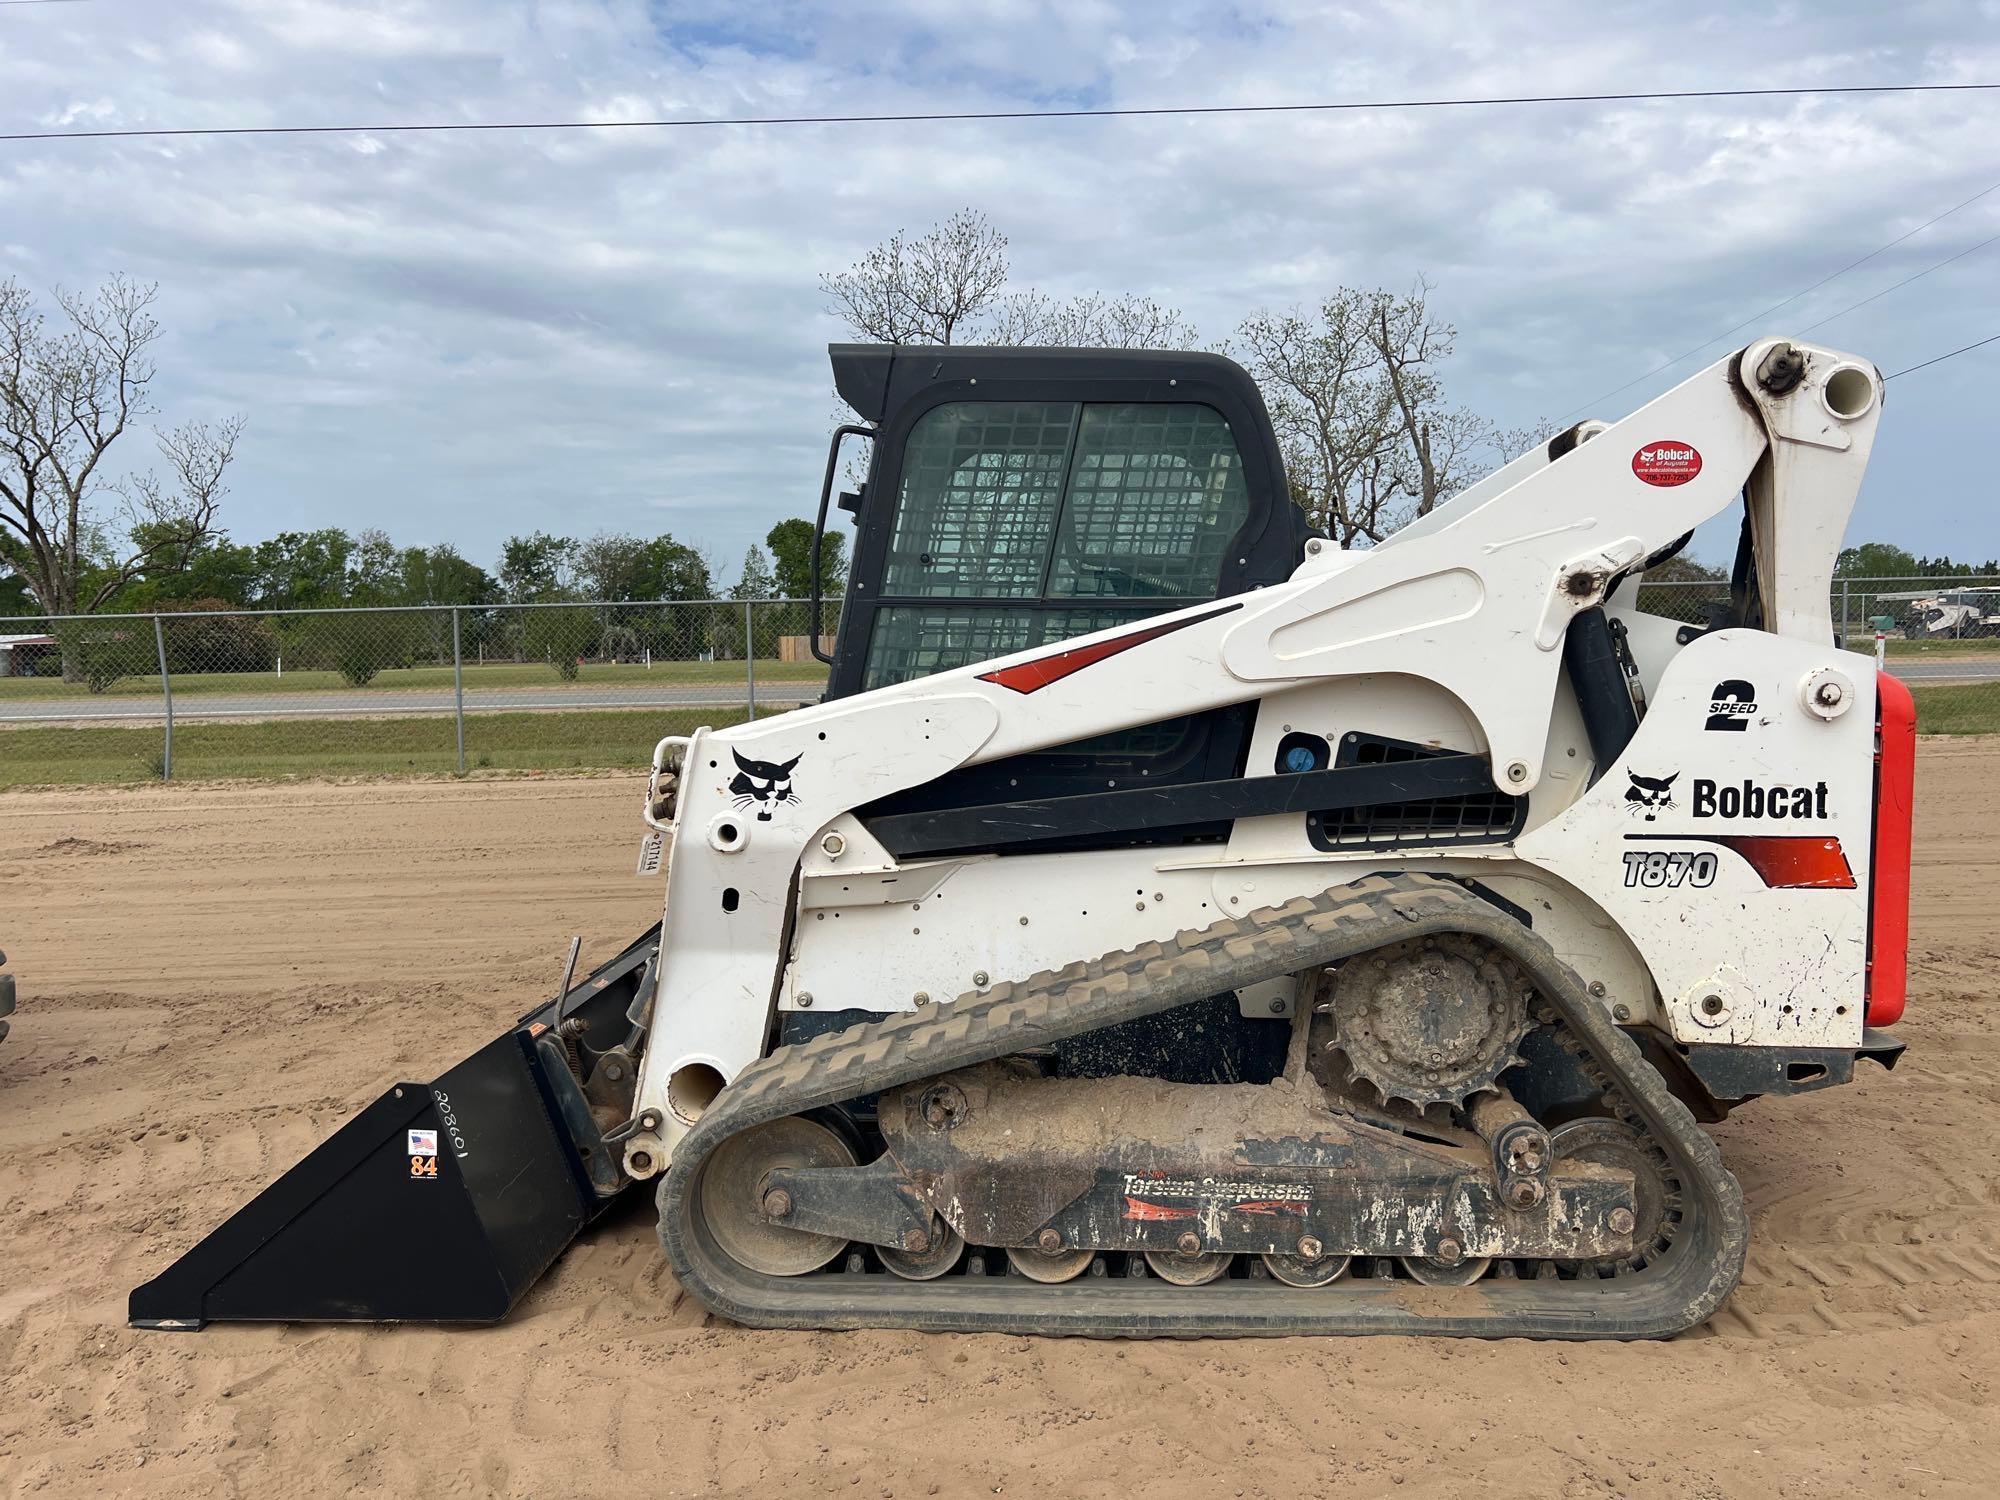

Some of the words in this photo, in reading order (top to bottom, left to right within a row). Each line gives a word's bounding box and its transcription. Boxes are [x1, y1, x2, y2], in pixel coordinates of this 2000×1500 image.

[1657, 448, 1694, 460] Bobcat
[1704, 679, 1756, 732] 2
[1708, 702, 1758, 714] SPEED
[1692, 779, 1829, 820] Bobcat
[646, 840, 662, 871] 217144
[1622, 851, 1718, 888] T870
[434, 1090, 469, 1158] 208601
[410, 1155, 438, 1176] 84
[1123, 1174, 1195, 1196] Torsion
[1200, 1177, 1315, 1203] Suspension
